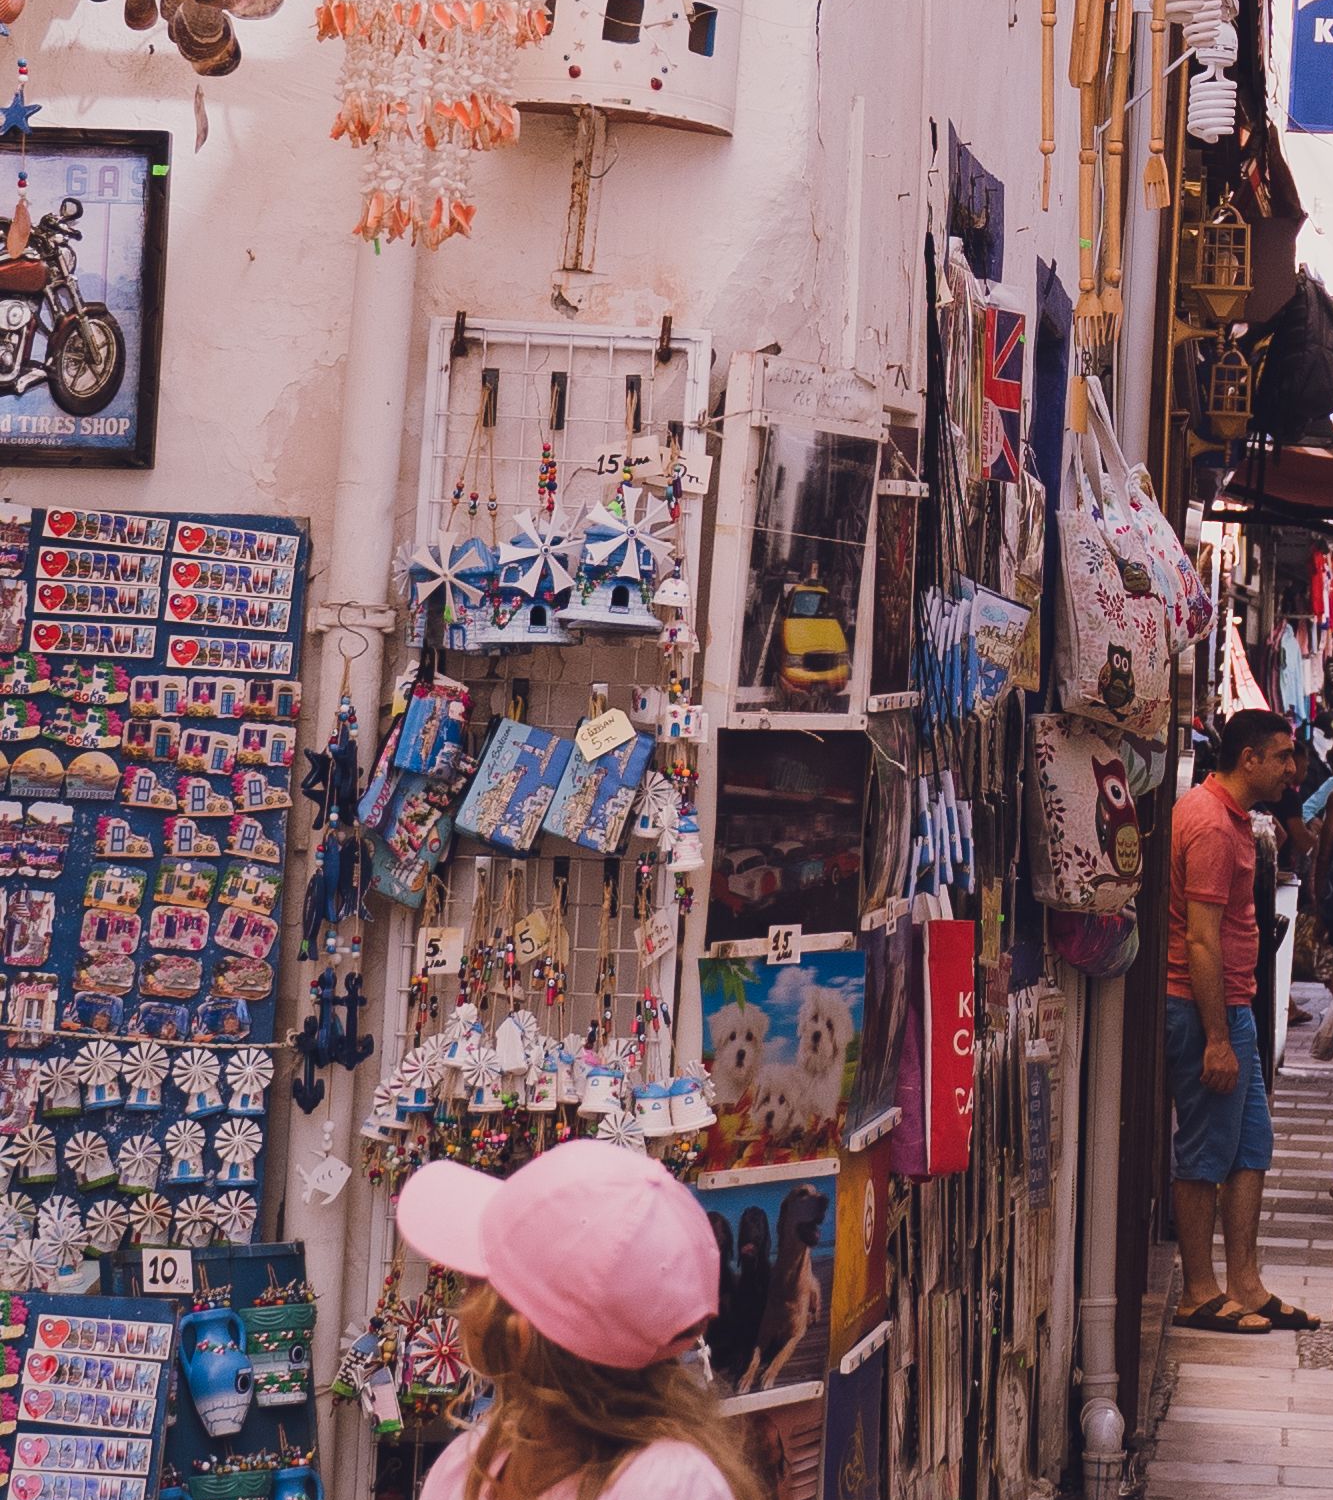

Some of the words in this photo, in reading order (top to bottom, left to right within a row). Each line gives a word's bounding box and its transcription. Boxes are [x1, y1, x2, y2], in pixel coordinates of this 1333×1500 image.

[65, 163, 148, 198] GAS
[18, 413, 76, 435] TIRES
[80, 415, 131, 436] SHOP
[10, 437, 63, 446] COMPANY
[597, 453, 622, 476] 15
[519, 928, 535, 954] 5
[149, 1256, 178, 1285] 10
